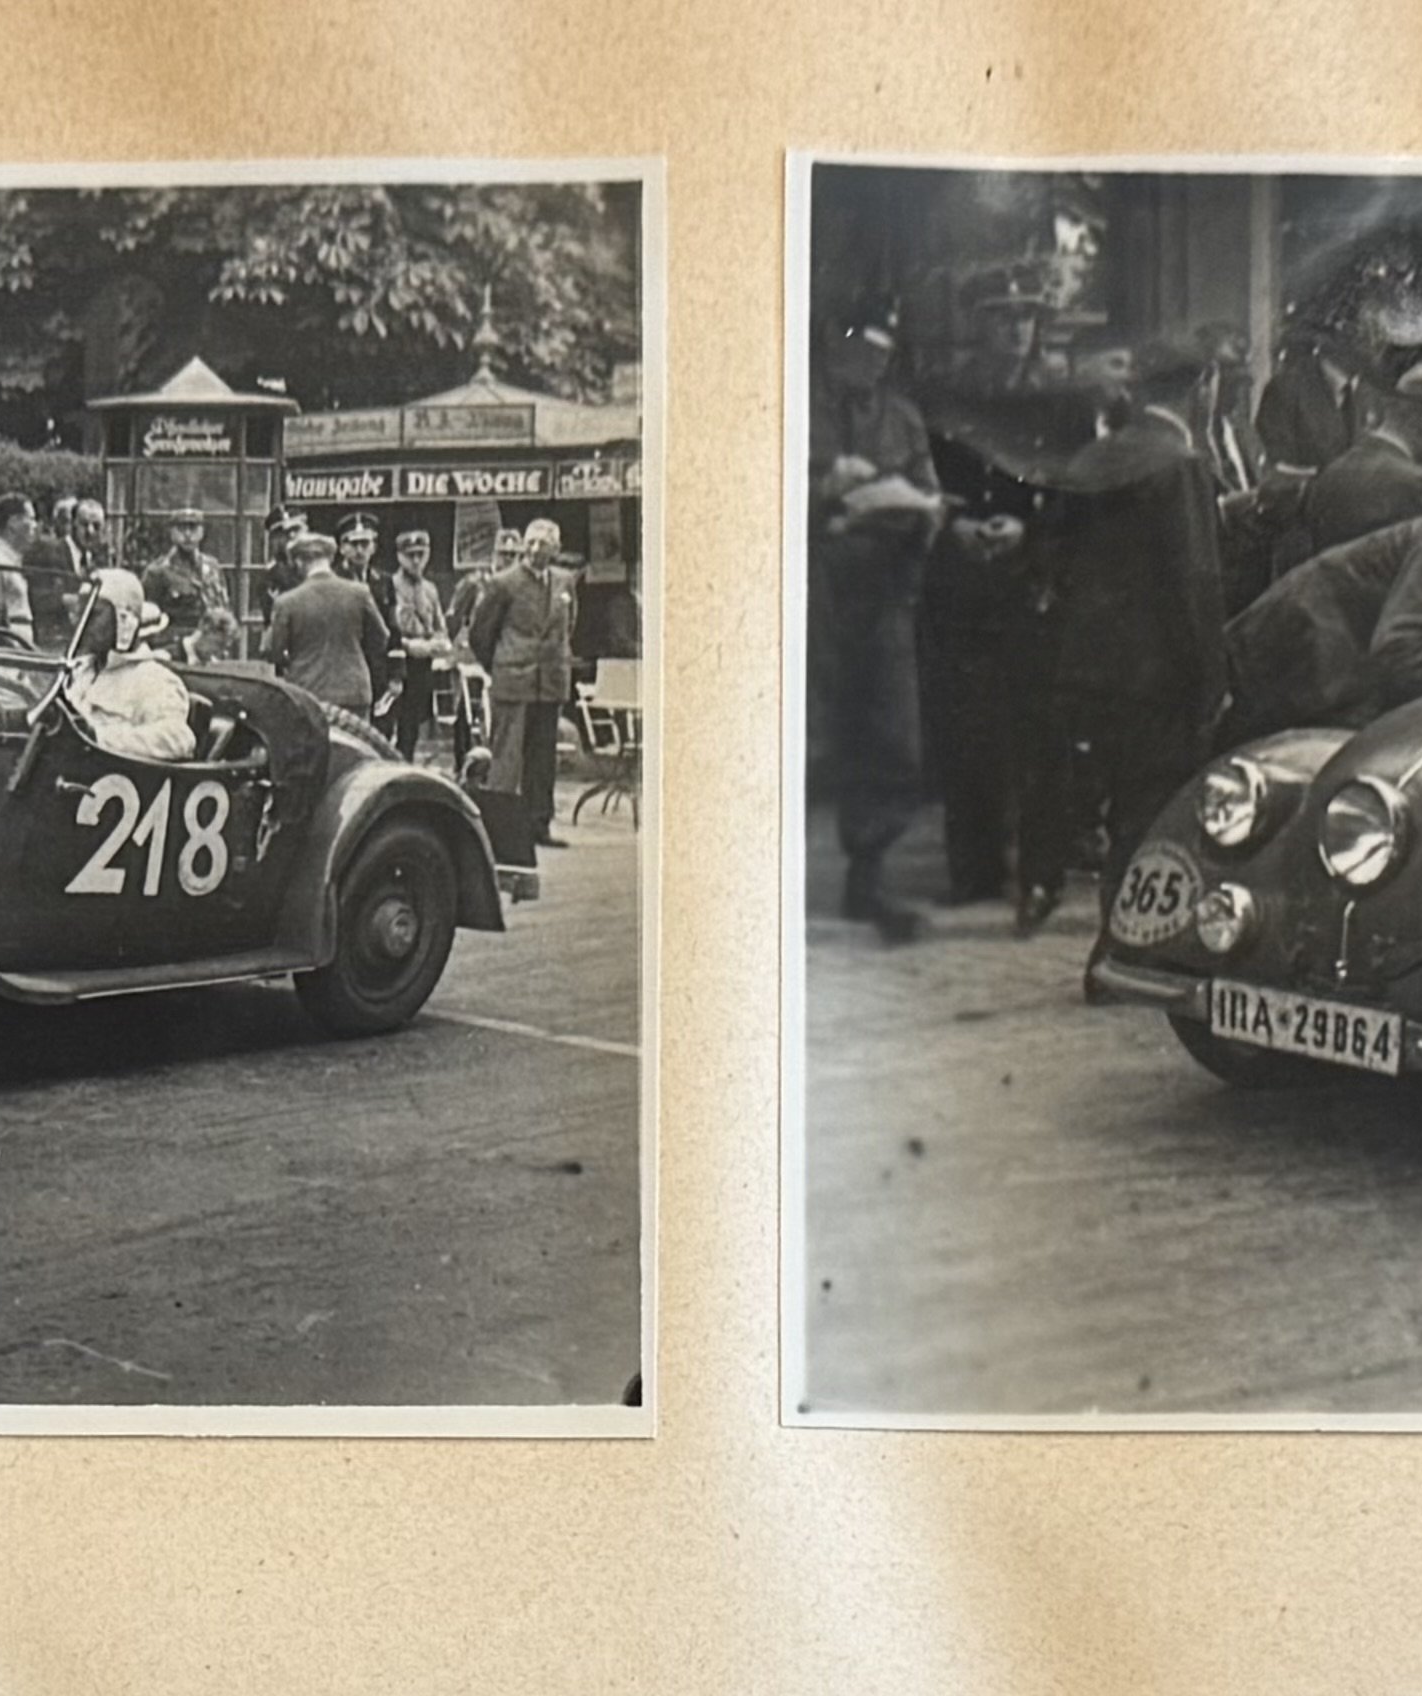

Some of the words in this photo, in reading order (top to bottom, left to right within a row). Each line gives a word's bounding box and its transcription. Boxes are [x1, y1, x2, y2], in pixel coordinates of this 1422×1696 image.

[407, 471, 449, 495] DIE
[451, 470, 543, 494] WOCHE
[65, 773, 230, 897] 218
[1119, 865, 1181, 917] 365
